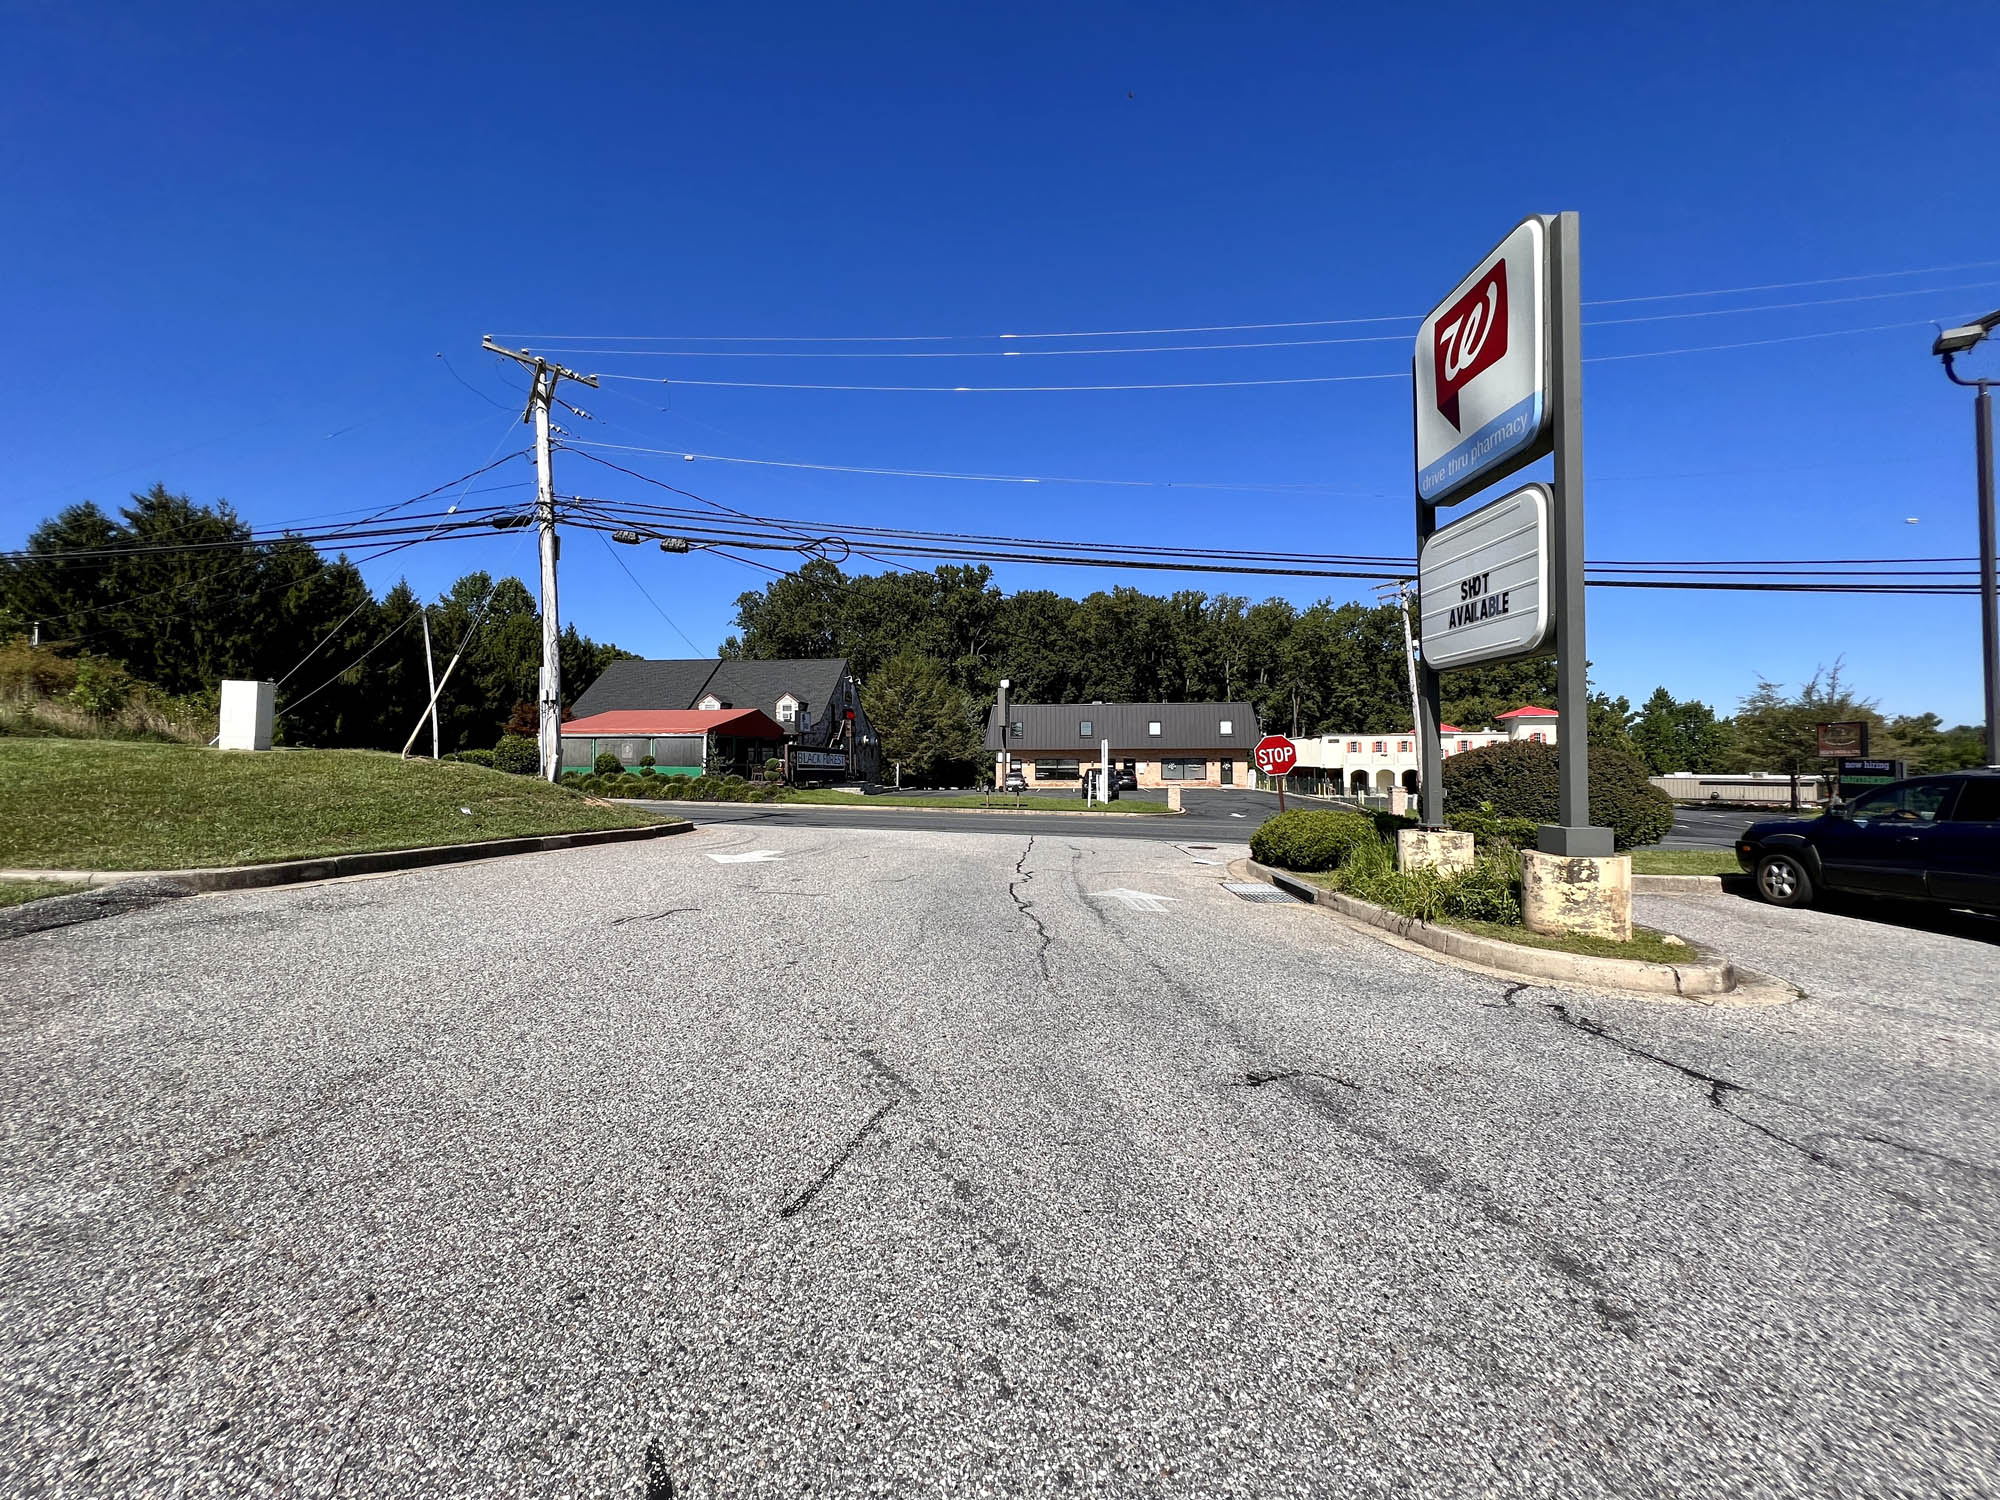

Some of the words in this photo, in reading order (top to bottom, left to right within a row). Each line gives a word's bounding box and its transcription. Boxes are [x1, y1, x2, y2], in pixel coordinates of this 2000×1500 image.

[1422, 467, 1446, 492] drive
[1448, 453, 1469, 476] thru
[1471, 414, 1528, 465] pharmacy
[1461, 572, 1489, 600] SHOT
[1449, 592, 1509, 629] AVAILABLE
[1258, 747, 1293, 764] STOP
[1863, 760, 1890, 771] hiring
